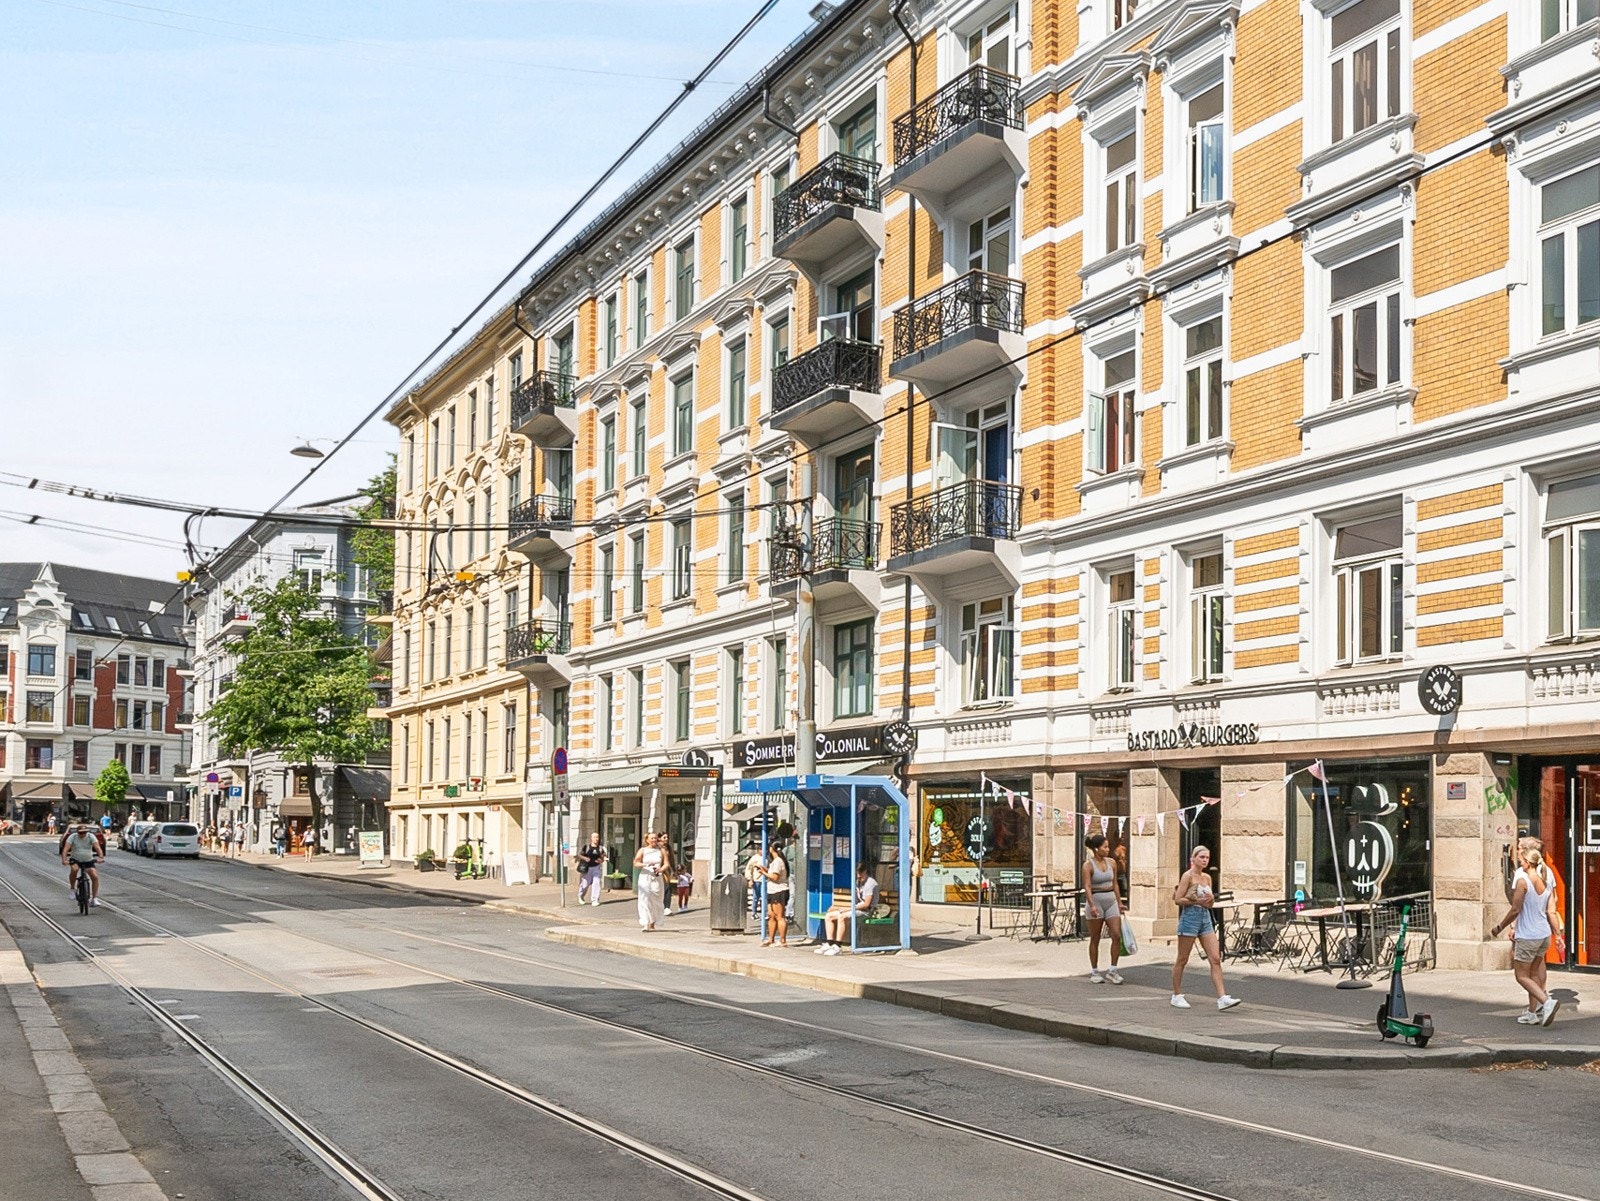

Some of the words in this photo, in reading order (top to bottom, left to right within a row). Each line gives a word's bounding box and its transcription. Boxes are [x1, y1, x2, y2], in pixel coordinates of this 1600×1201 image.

[1428, 667, 1455, 682] BASTARD
[1429, 697, 1457, 712] BURGERS
[1127, 729, 1178, 752] BASTARD
[1199, 722, 1257, 748] BURGERS
[815, 733, 871, 760] COLONIAL
[231, 787, 240, 796] P
